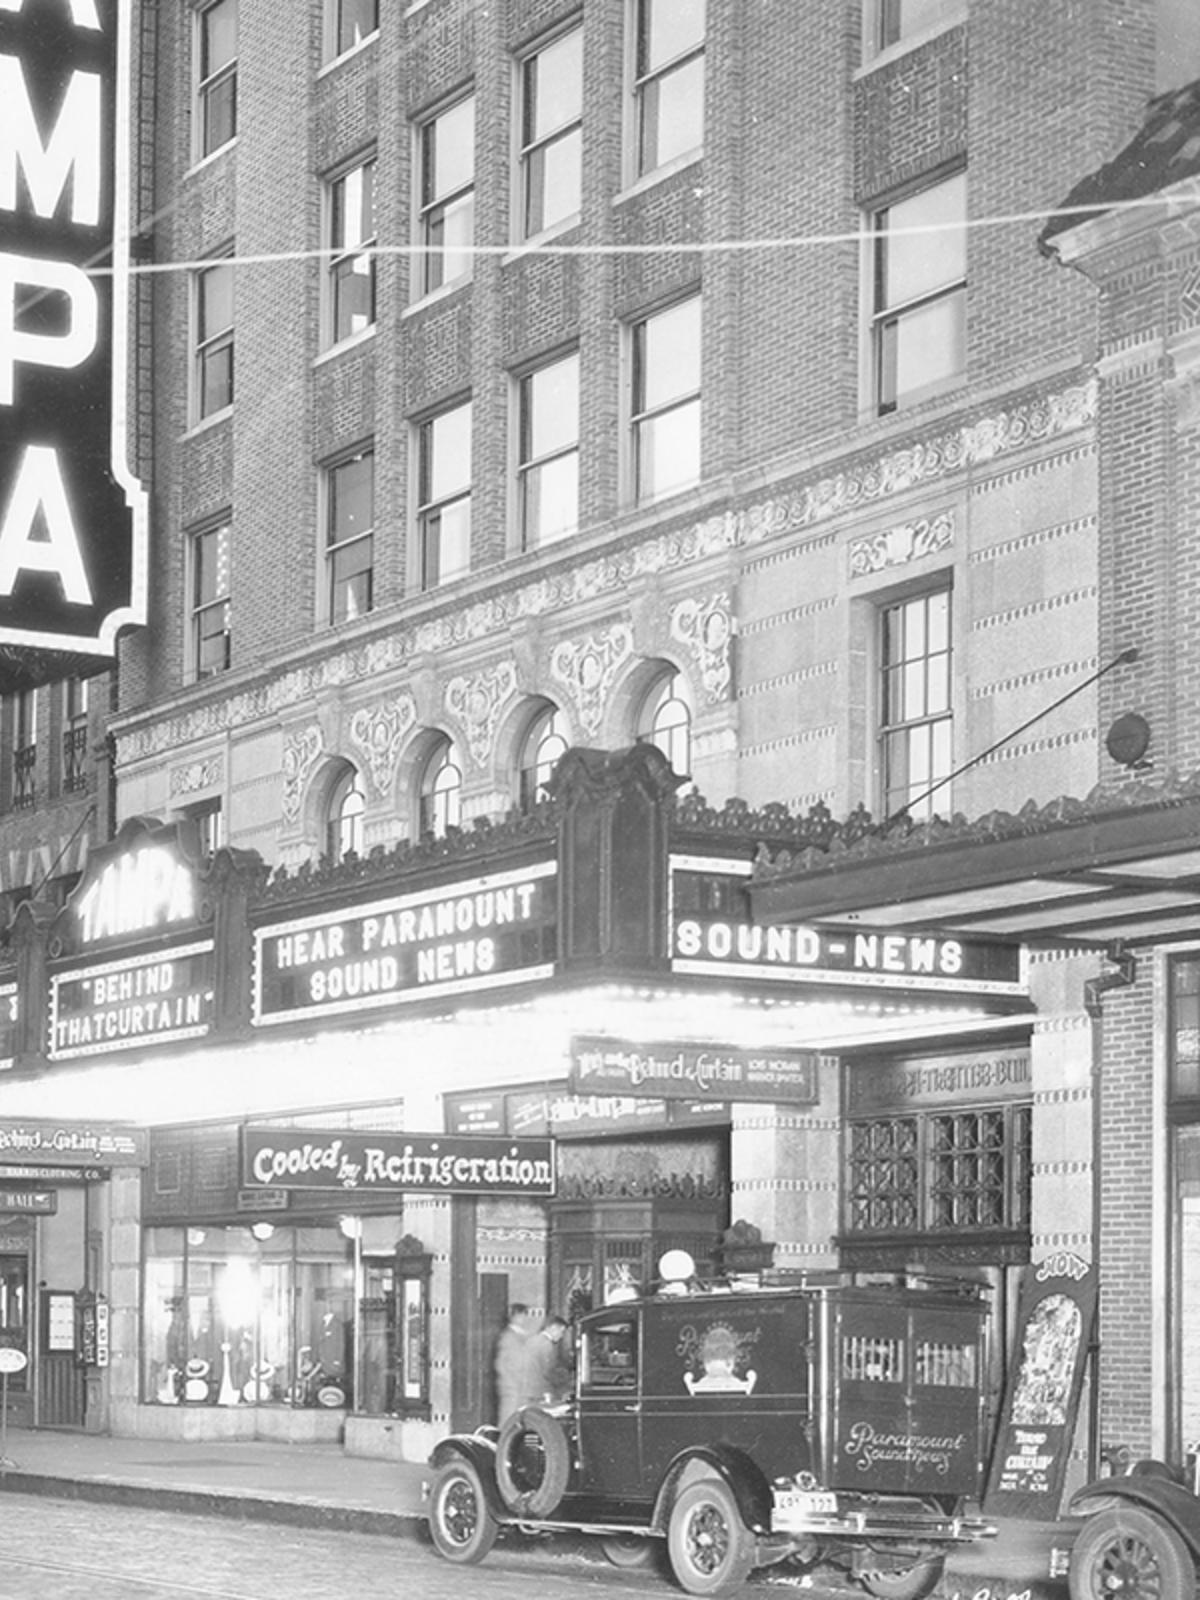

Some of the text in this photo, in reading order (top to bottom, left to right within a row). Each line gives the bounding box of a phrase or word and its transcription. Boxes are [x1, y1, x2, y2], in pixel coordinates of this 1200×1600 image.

[78, 847, 194, 942] TAMPA
[277, 884, 536, 968] HEAR PARAMOUNT
[310, 937, 495, 1001] SOUND NEWS
[253, 1140, 553, 1187] Cooled by Refrigeration
[1036, 1251, 1090, 1281] NOW
[845, 1421, 966, 1455] Paramount
